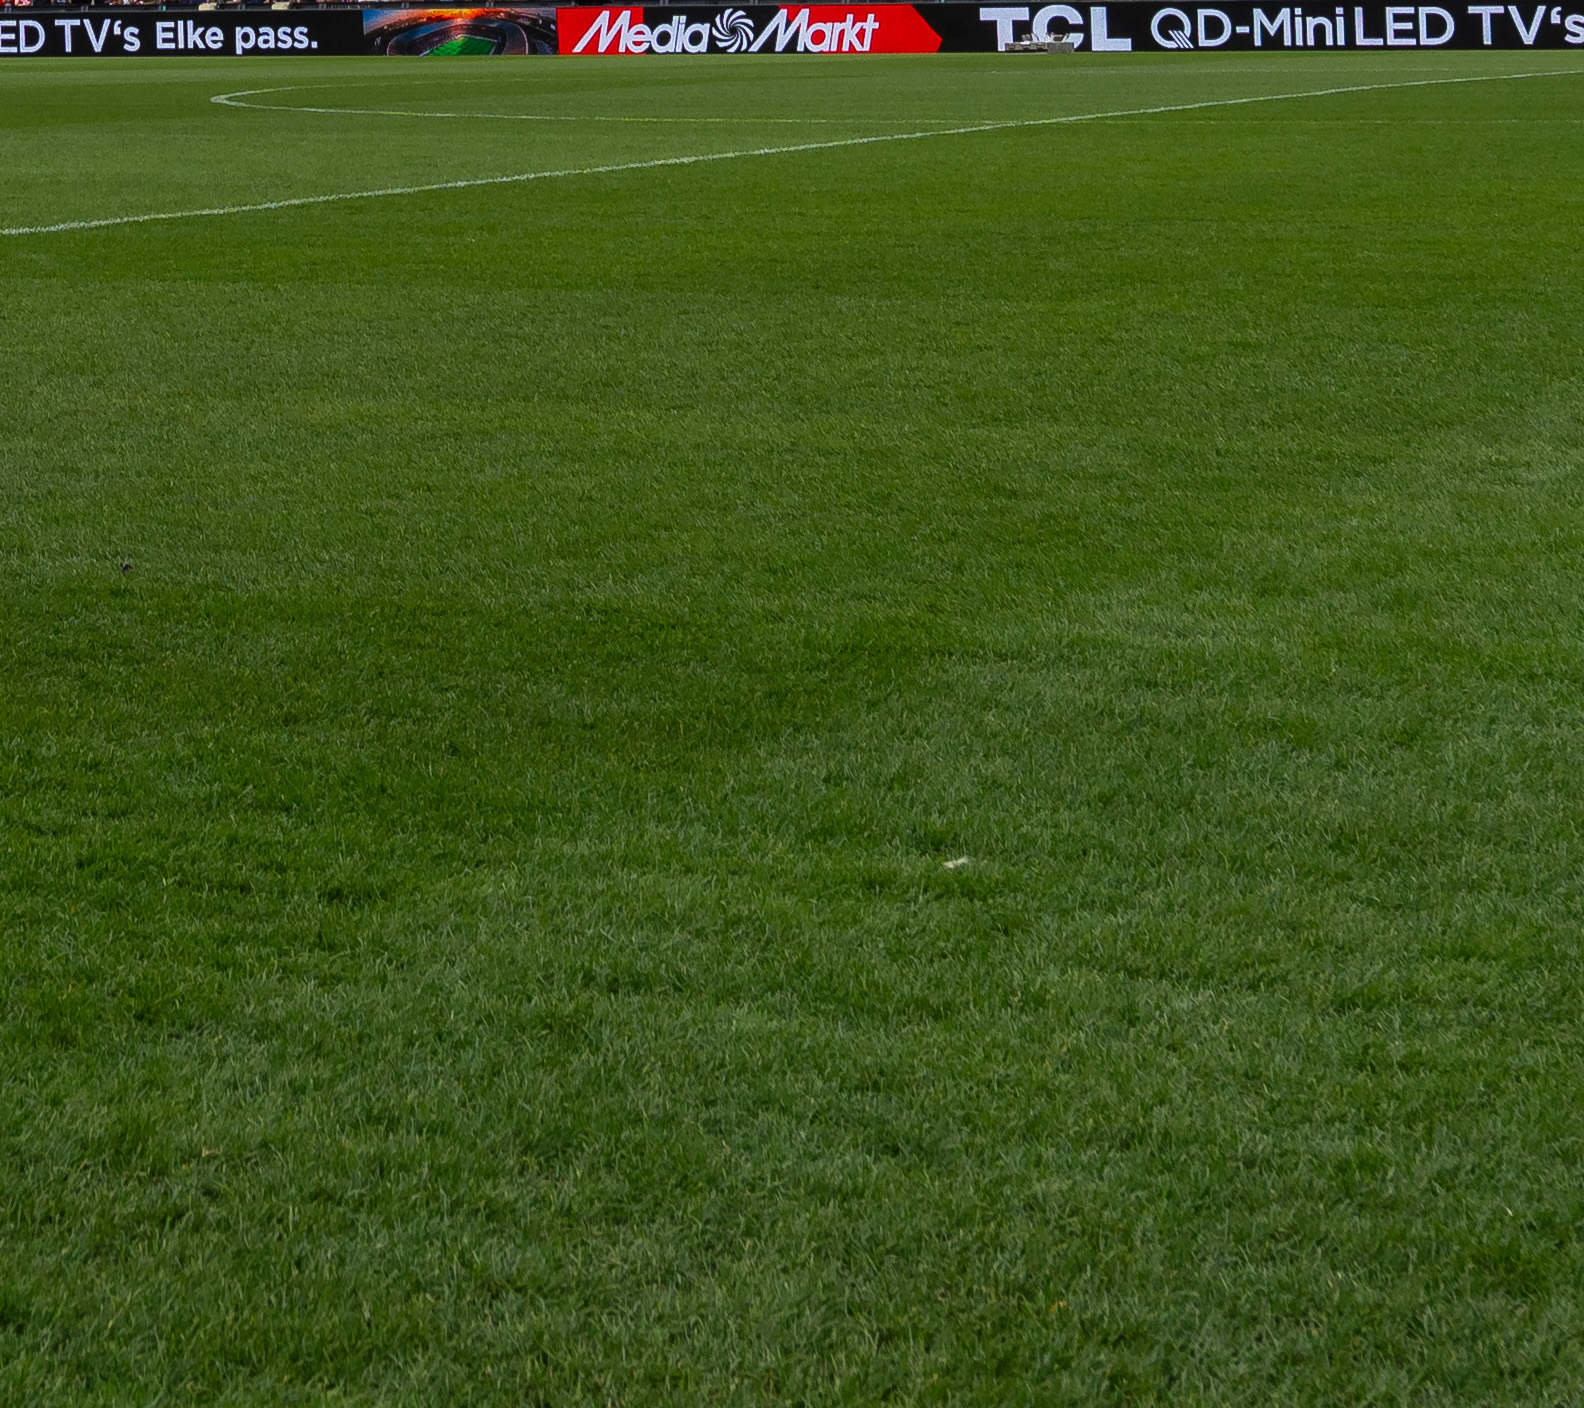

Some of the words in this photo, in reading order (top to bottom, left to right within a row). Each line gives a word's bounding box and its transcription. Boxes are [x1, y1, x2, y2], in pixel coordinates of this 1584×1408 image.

[156, 20, 224, 50] Elke
[235, 26, 318, 55] pass.
[979, 4, 1132, 52] TCL
